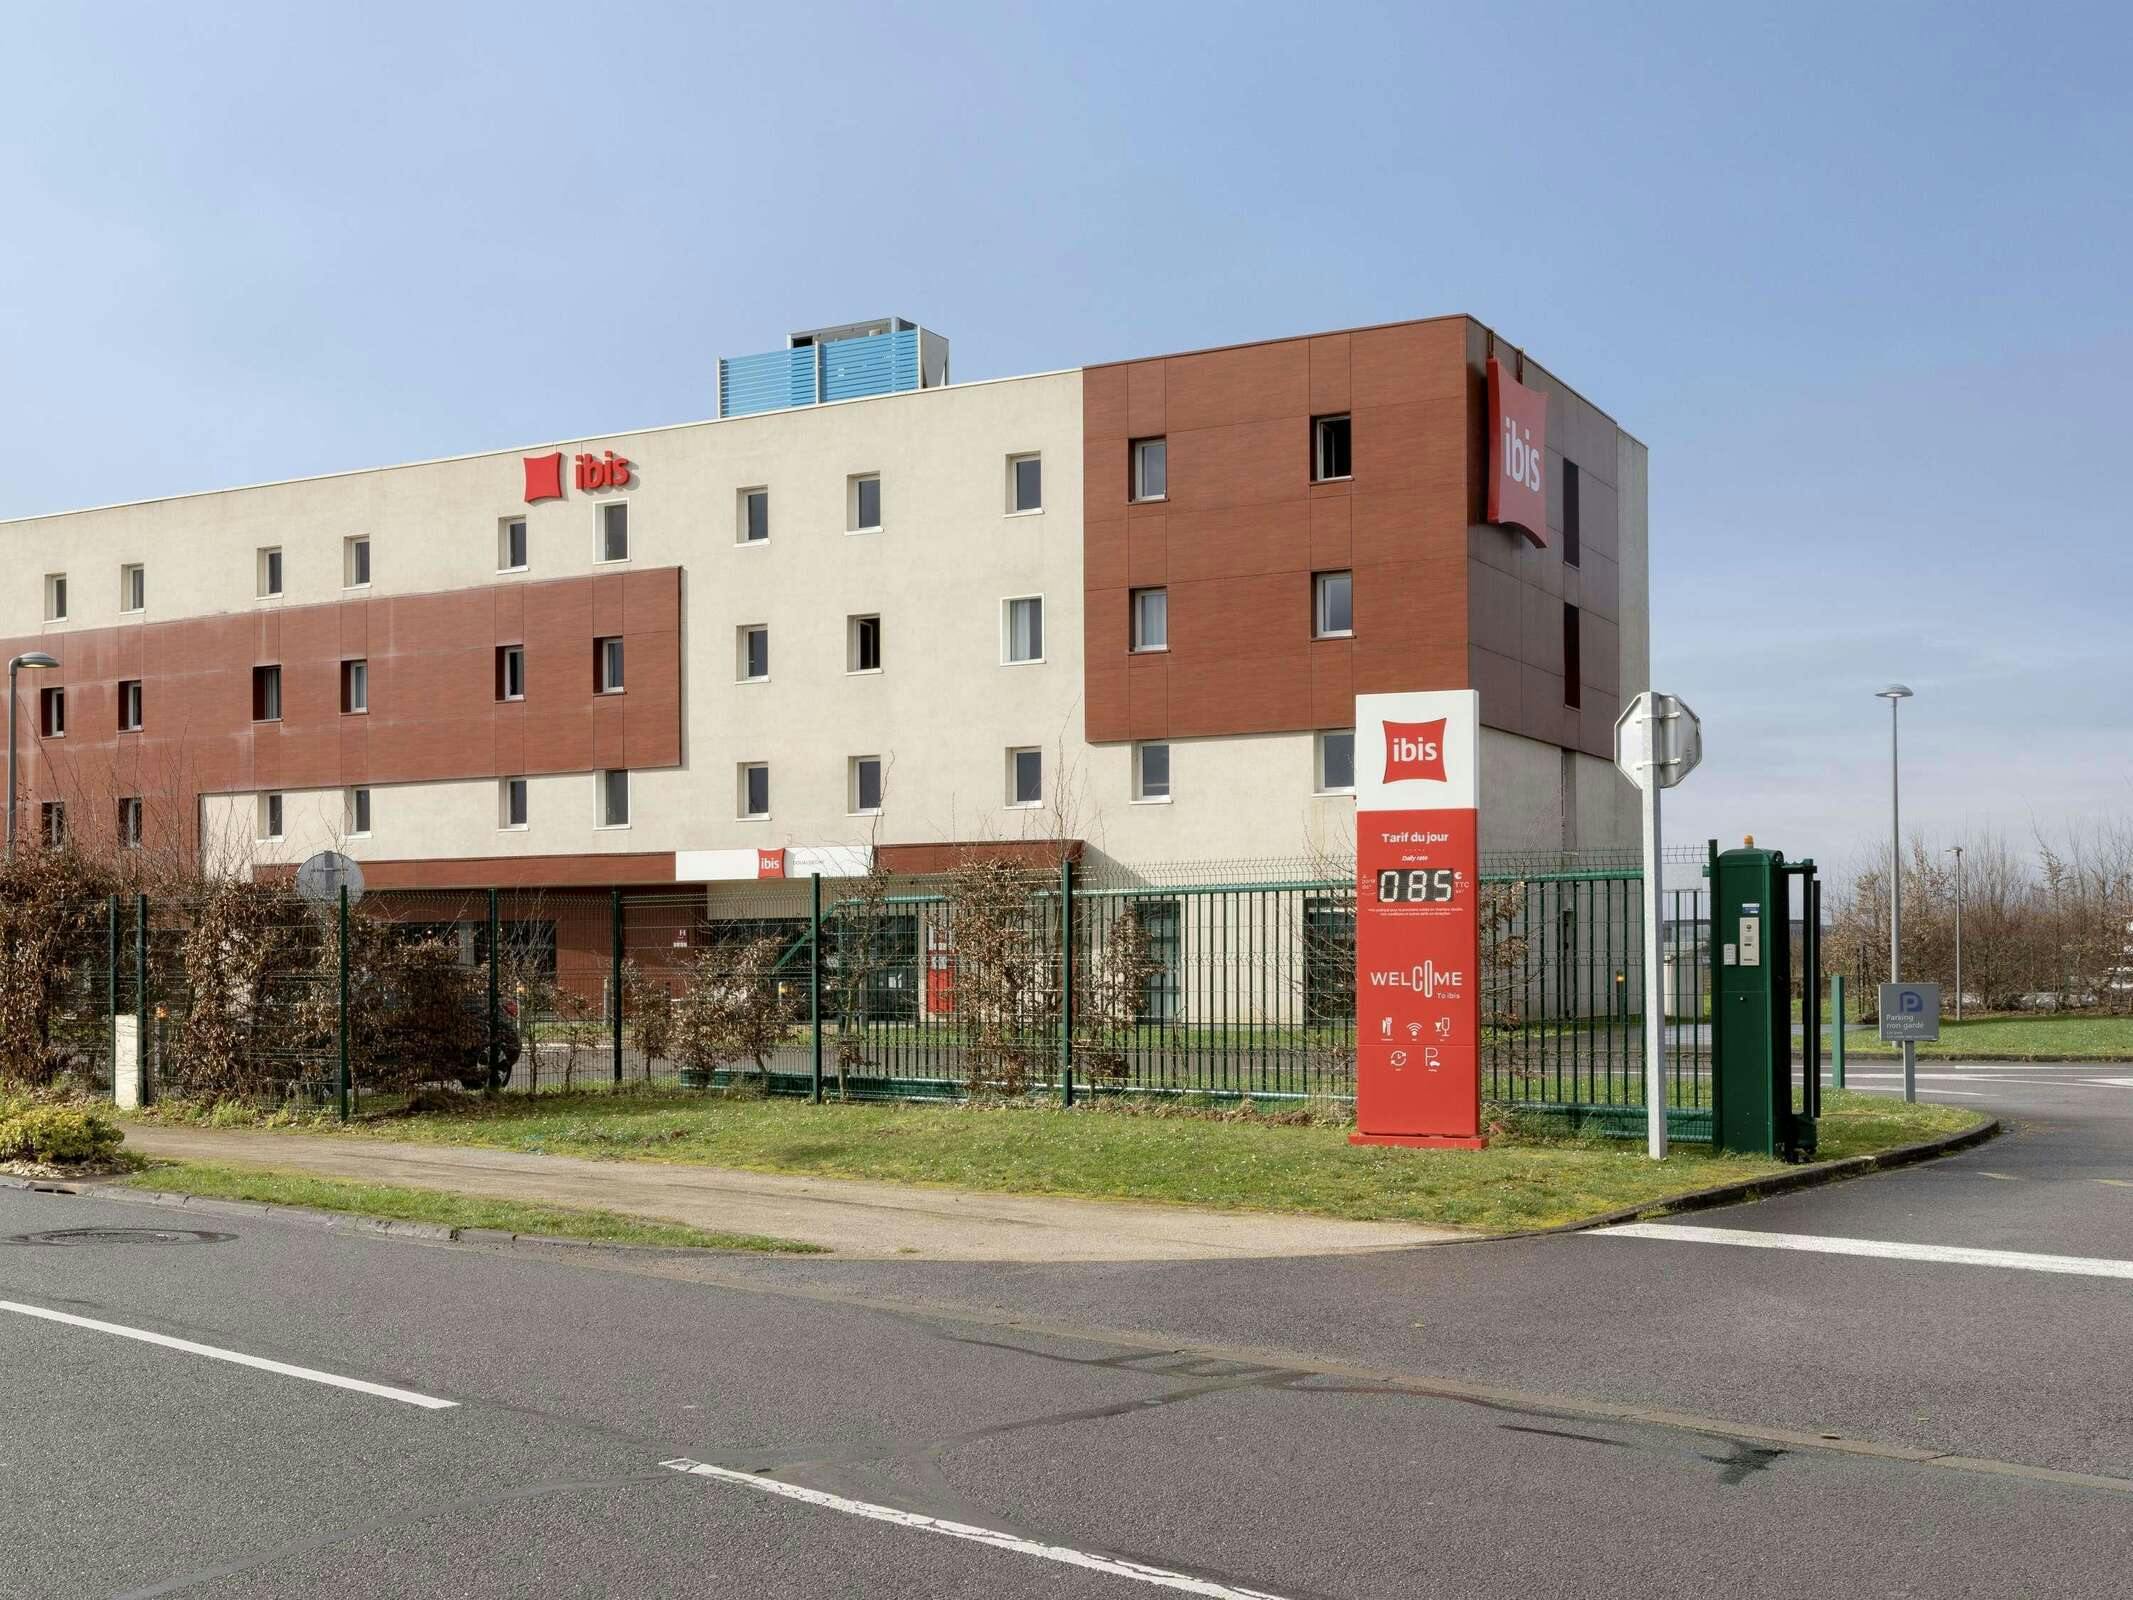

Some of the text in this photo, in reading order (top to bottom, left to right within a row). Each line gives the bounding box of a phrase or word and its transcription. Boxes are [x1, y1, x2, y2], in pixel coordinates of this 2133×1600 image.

[1504, 416, 1541, 493] ibis
[575, 450, 630, 490] ibis
[1393, 737, 1438, 762] ibis
[1381, 831, 1449, 844] Tarif du jour
[760, 858, 780, 870] ibis
[1379, 869, 1452, 903] 085
[1370, 959, 1463, 998] WELCOME
[1886, 1014, 1914, 1022] Parking
